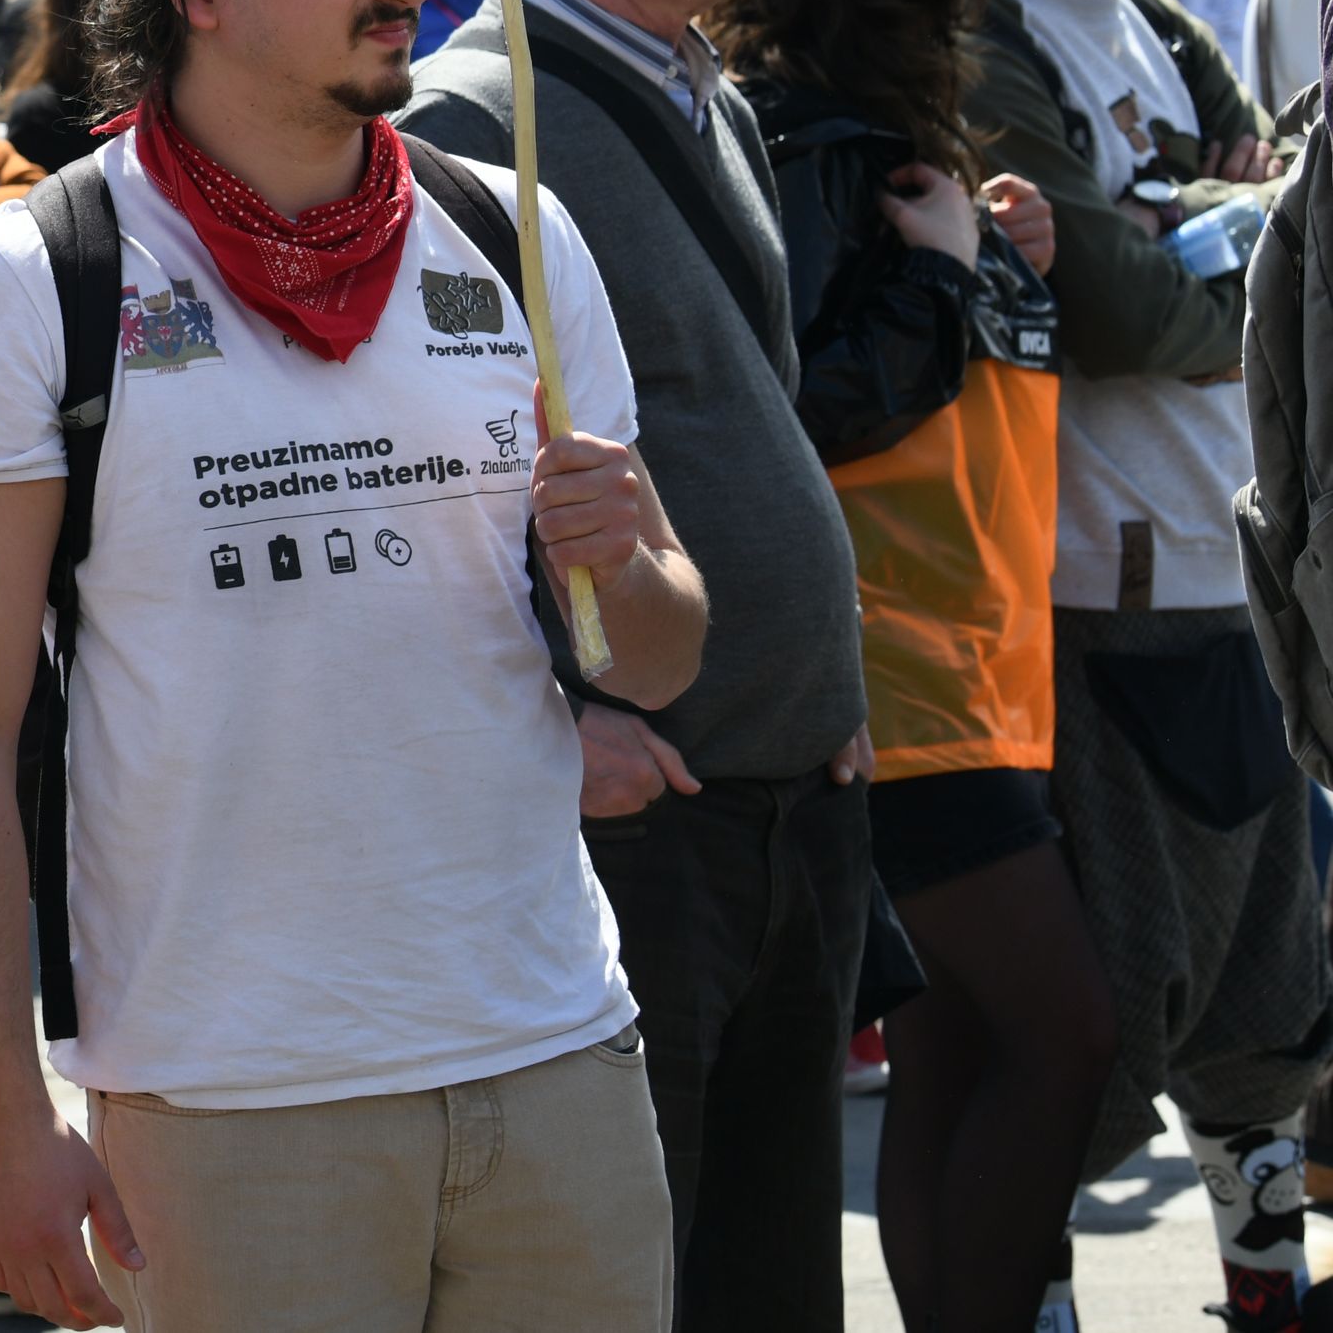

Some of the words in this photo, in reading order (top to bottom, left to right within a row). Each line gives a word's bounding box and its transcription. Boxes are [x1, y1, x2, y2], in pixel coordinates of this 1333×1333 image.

[425, 342, 484, 358] Porečje
[490, 341, 528, 357] Vučje
[192, 436, 394, 479] Preuzimamo
[198, 471, 339, 509] otpadne
[344, 454, 471, 491] baterije.
